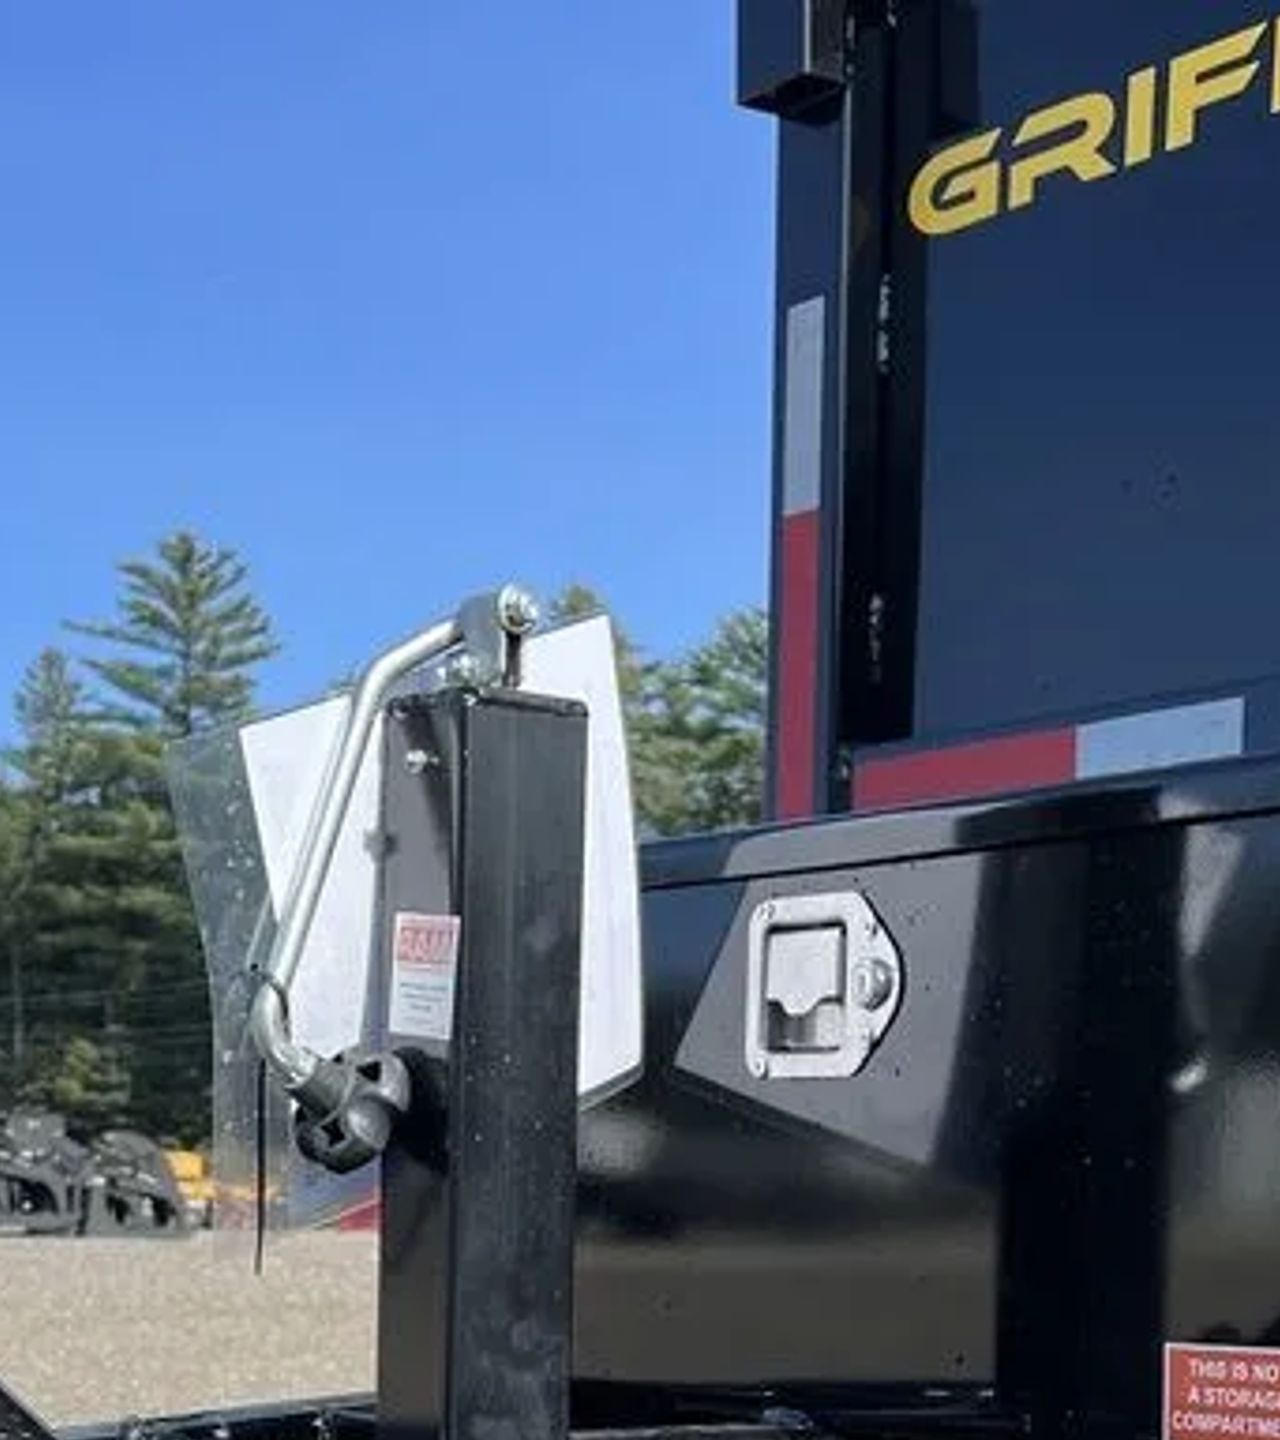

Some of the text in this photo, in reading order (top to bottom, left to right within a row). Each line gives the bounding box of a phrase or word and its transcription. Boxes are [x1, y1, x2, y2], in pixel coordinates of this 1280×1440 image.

[1189, 1357, 1226, 1379] THIS
[1232, 1361, 1249, 1381] IS
[1188, 1385, 1200, 1405] A
